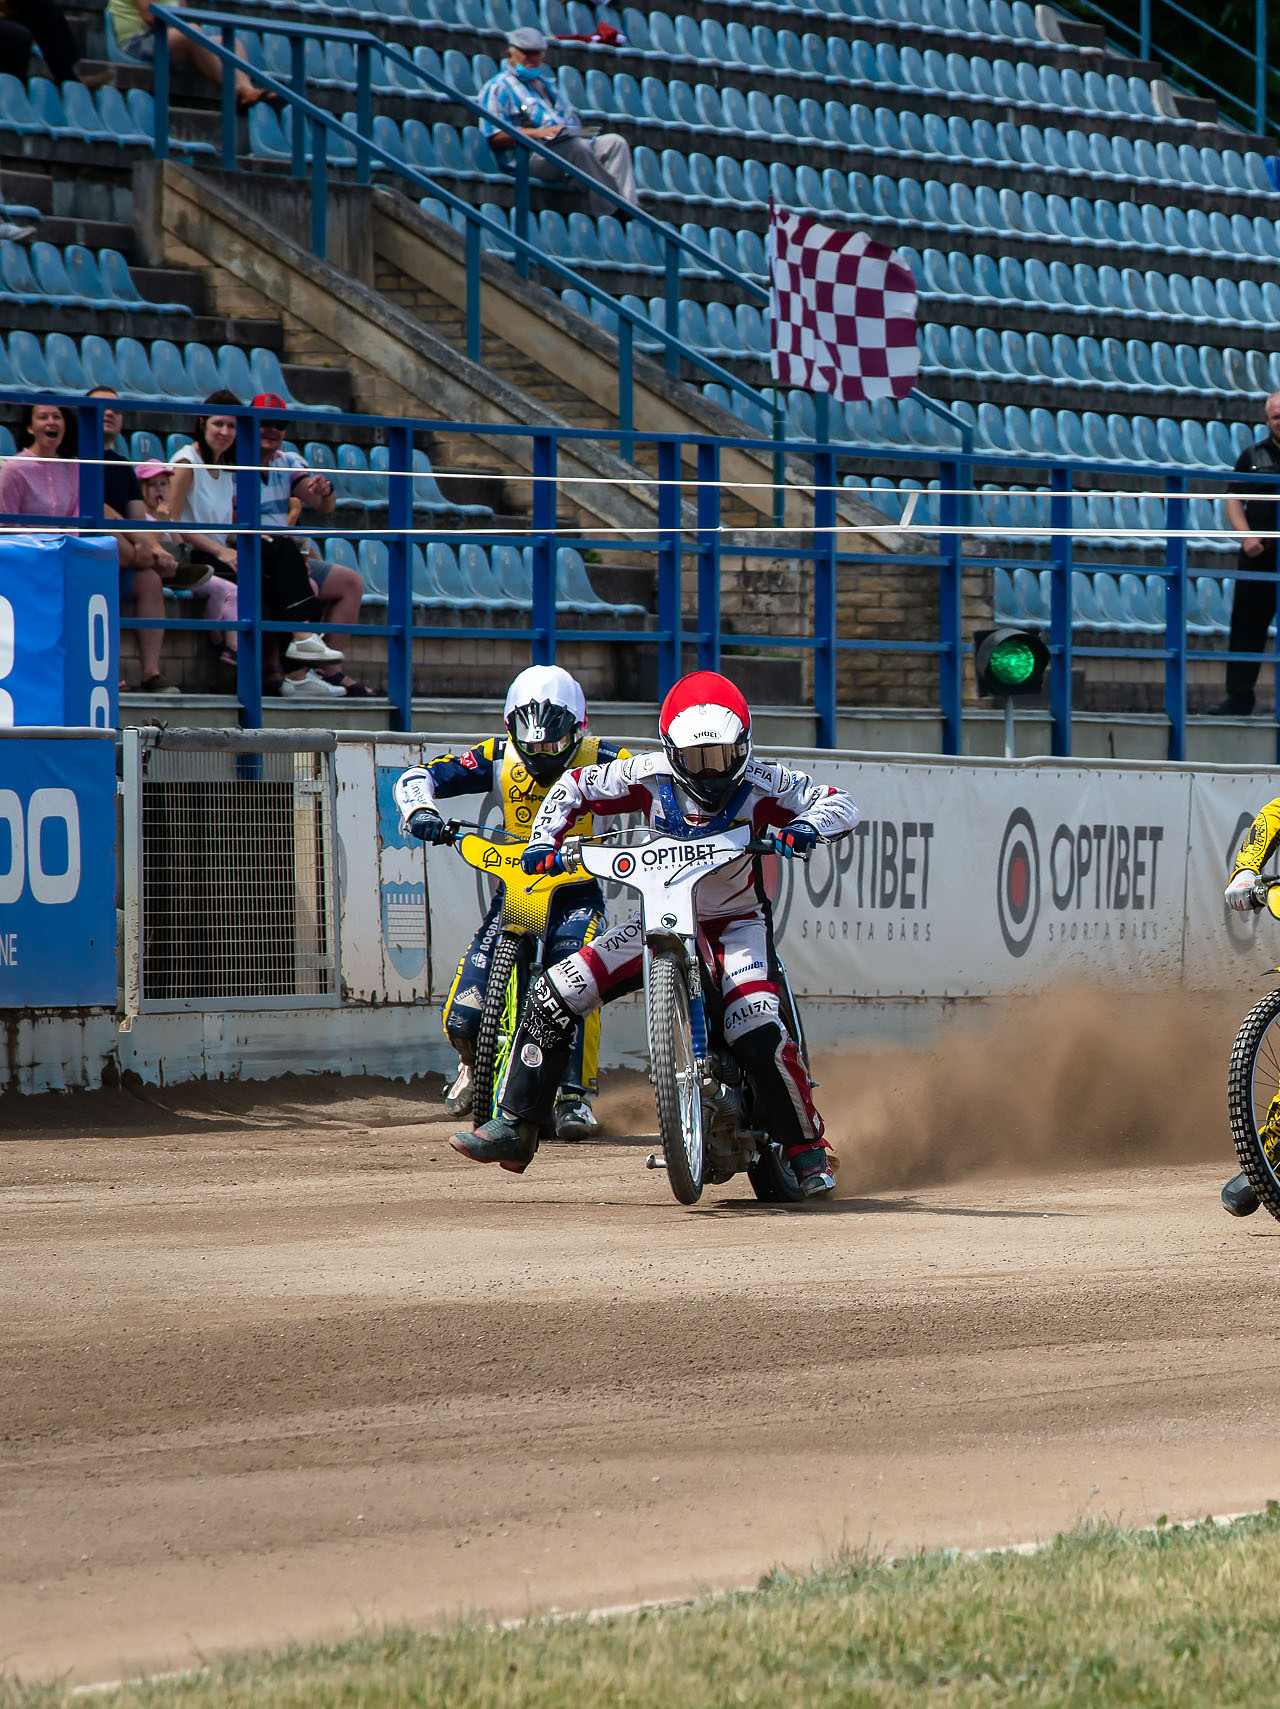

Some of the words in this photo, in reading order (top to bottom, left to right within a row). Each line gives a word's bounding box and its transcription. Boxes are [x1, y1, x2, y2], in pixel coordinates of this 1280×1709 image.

[641, 844, 716, 866] OPTIBET
[1050, 823, 1165, 911] OPTIBET
[801, 919, 875, 941] SPORTA
